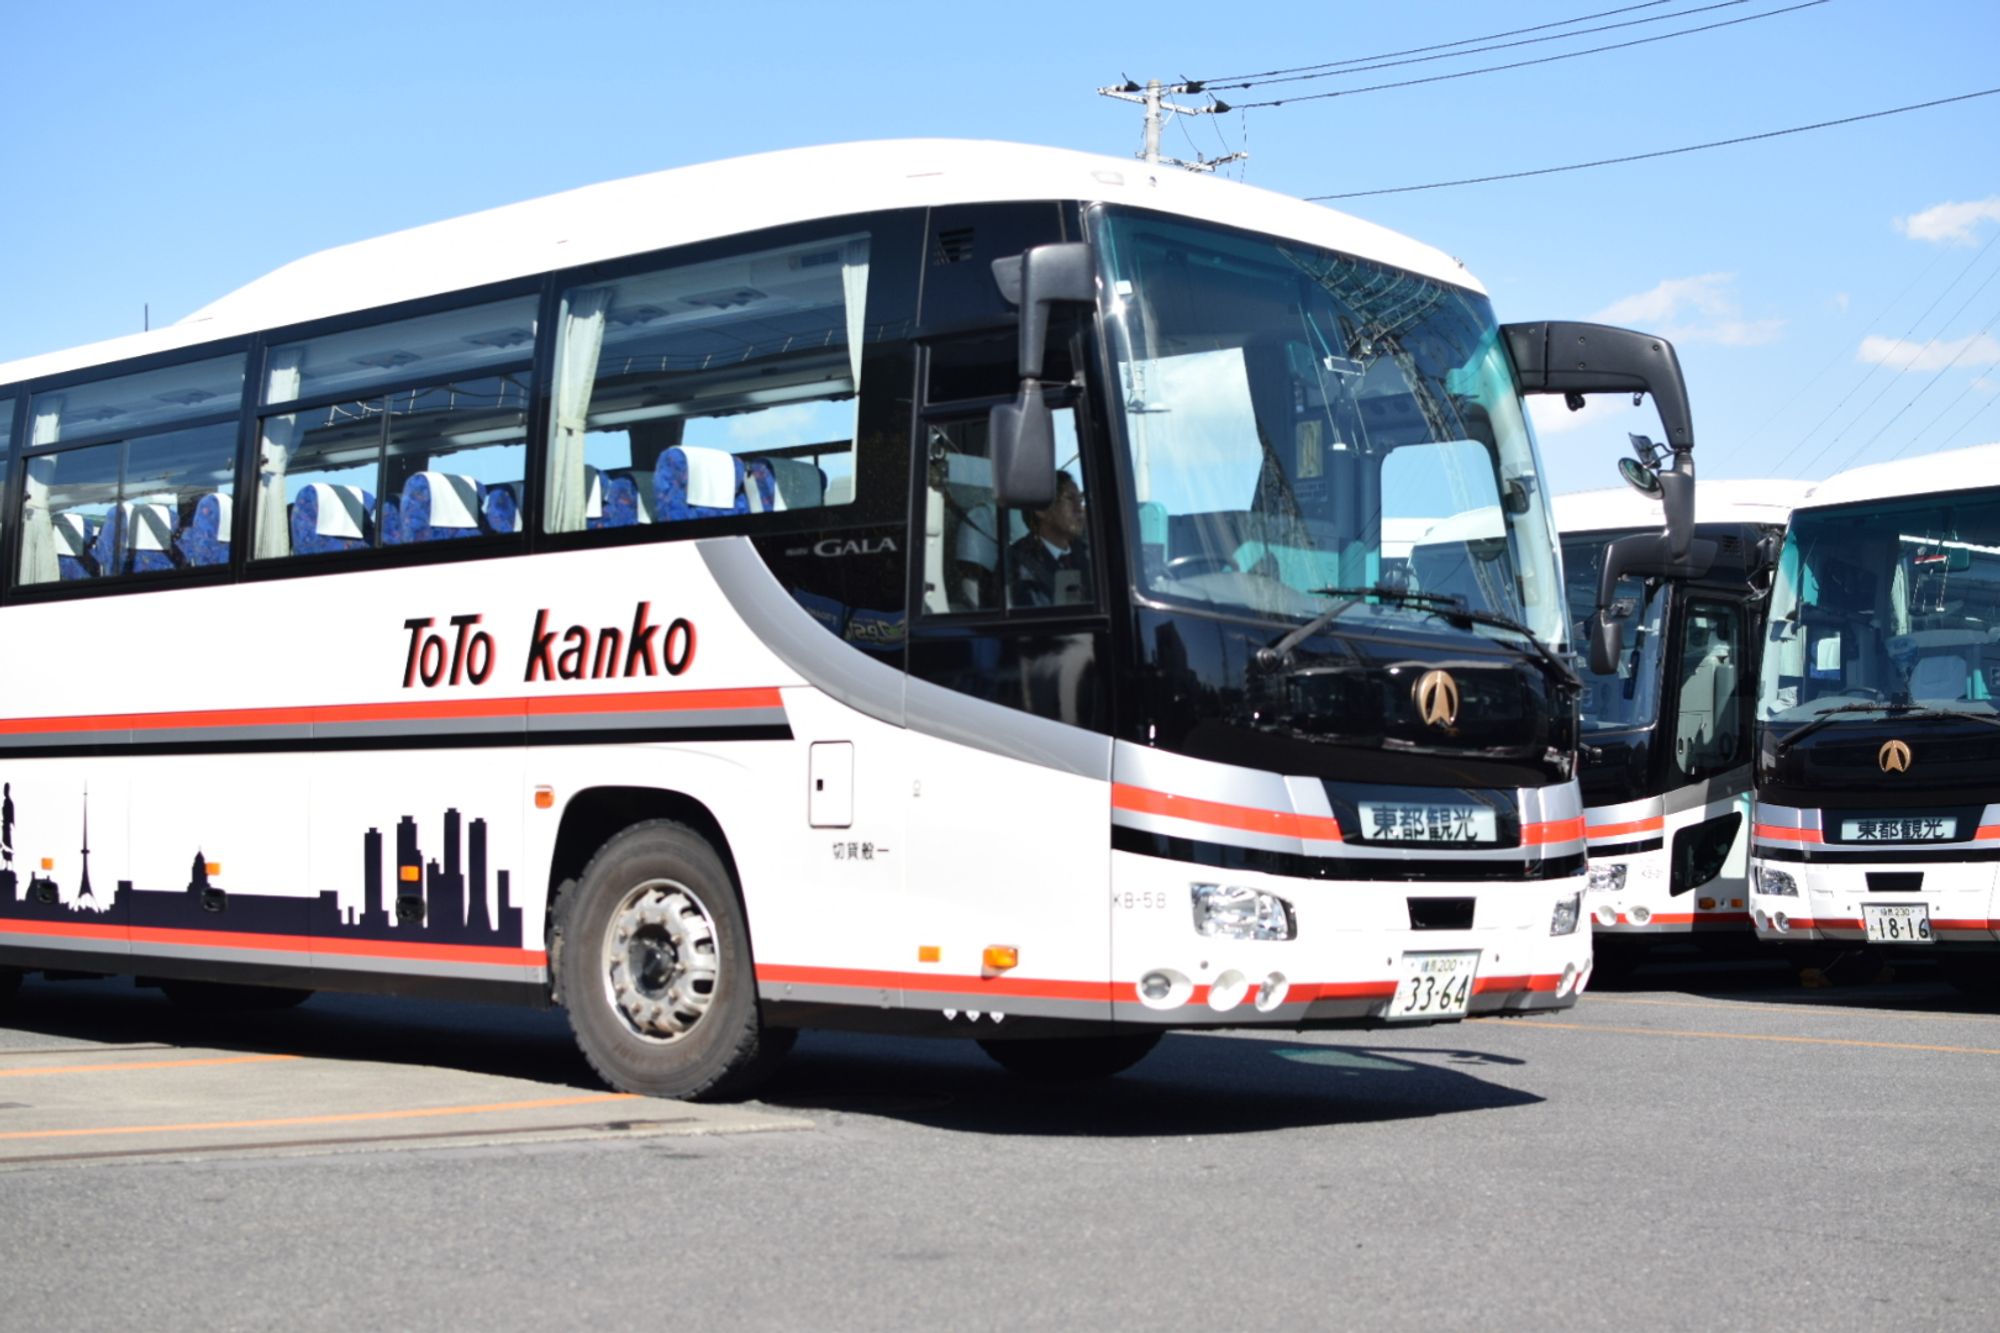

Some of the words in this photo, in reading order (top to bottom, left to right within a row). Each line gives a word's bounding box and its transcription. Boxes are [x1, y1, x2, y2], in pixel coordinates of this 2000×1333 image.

[814, 537, 898, 558] GALA
[402, 612, 497, 688] ToTo
[523, 600, 698, 682] kanko
[1371, 805, 1478, 841] 東都観光
[1857, 818, 1945, 839] 東都観光
